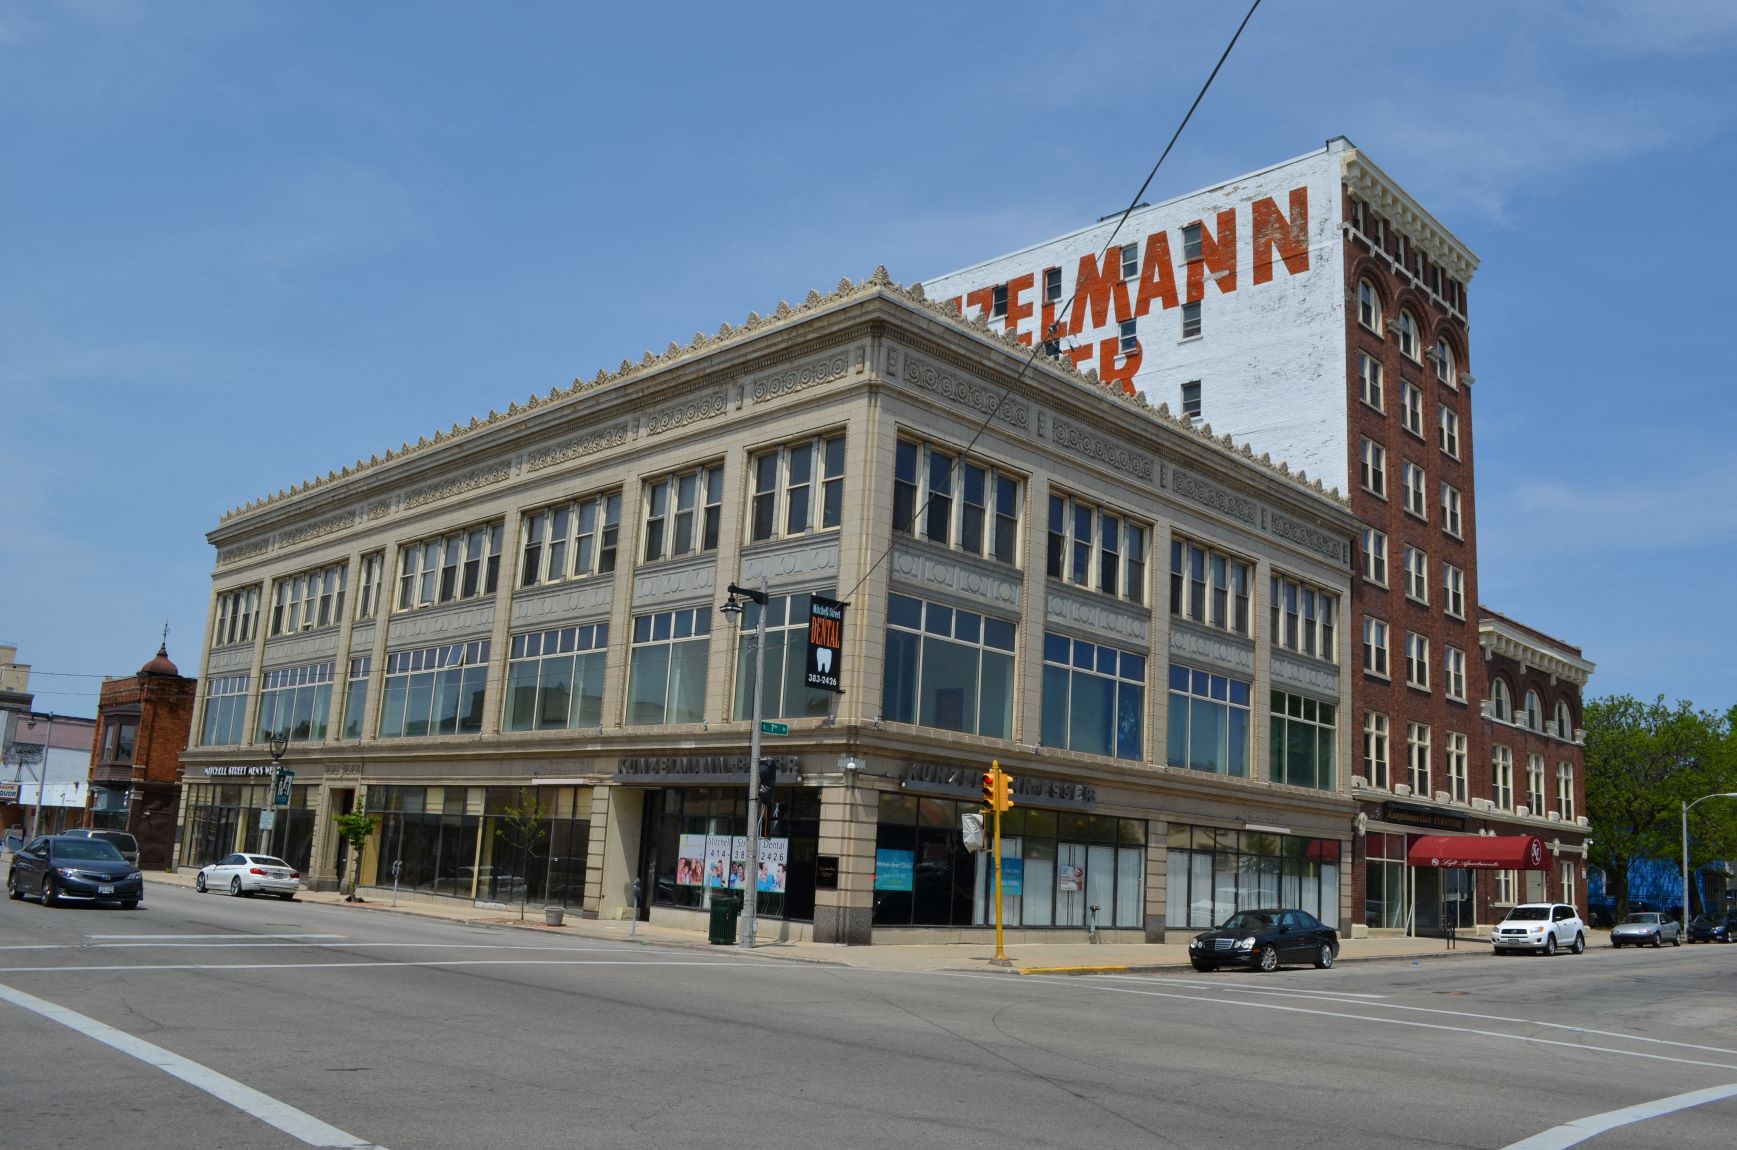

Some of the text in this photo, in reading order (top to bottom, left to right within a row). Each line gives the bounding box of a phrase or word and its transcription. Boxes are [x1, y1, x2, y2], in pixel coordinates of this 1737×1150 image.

[938, 186, 1310, 347] ZELMANN
[810, 616, 840, 649] DENTAL
[808, 673, 837, 686] 383-2426
[204, 766, 227, 776] MITCHELL
[228, 766, 248, 776] STREET
[763, 839, 785, 850] Dental
